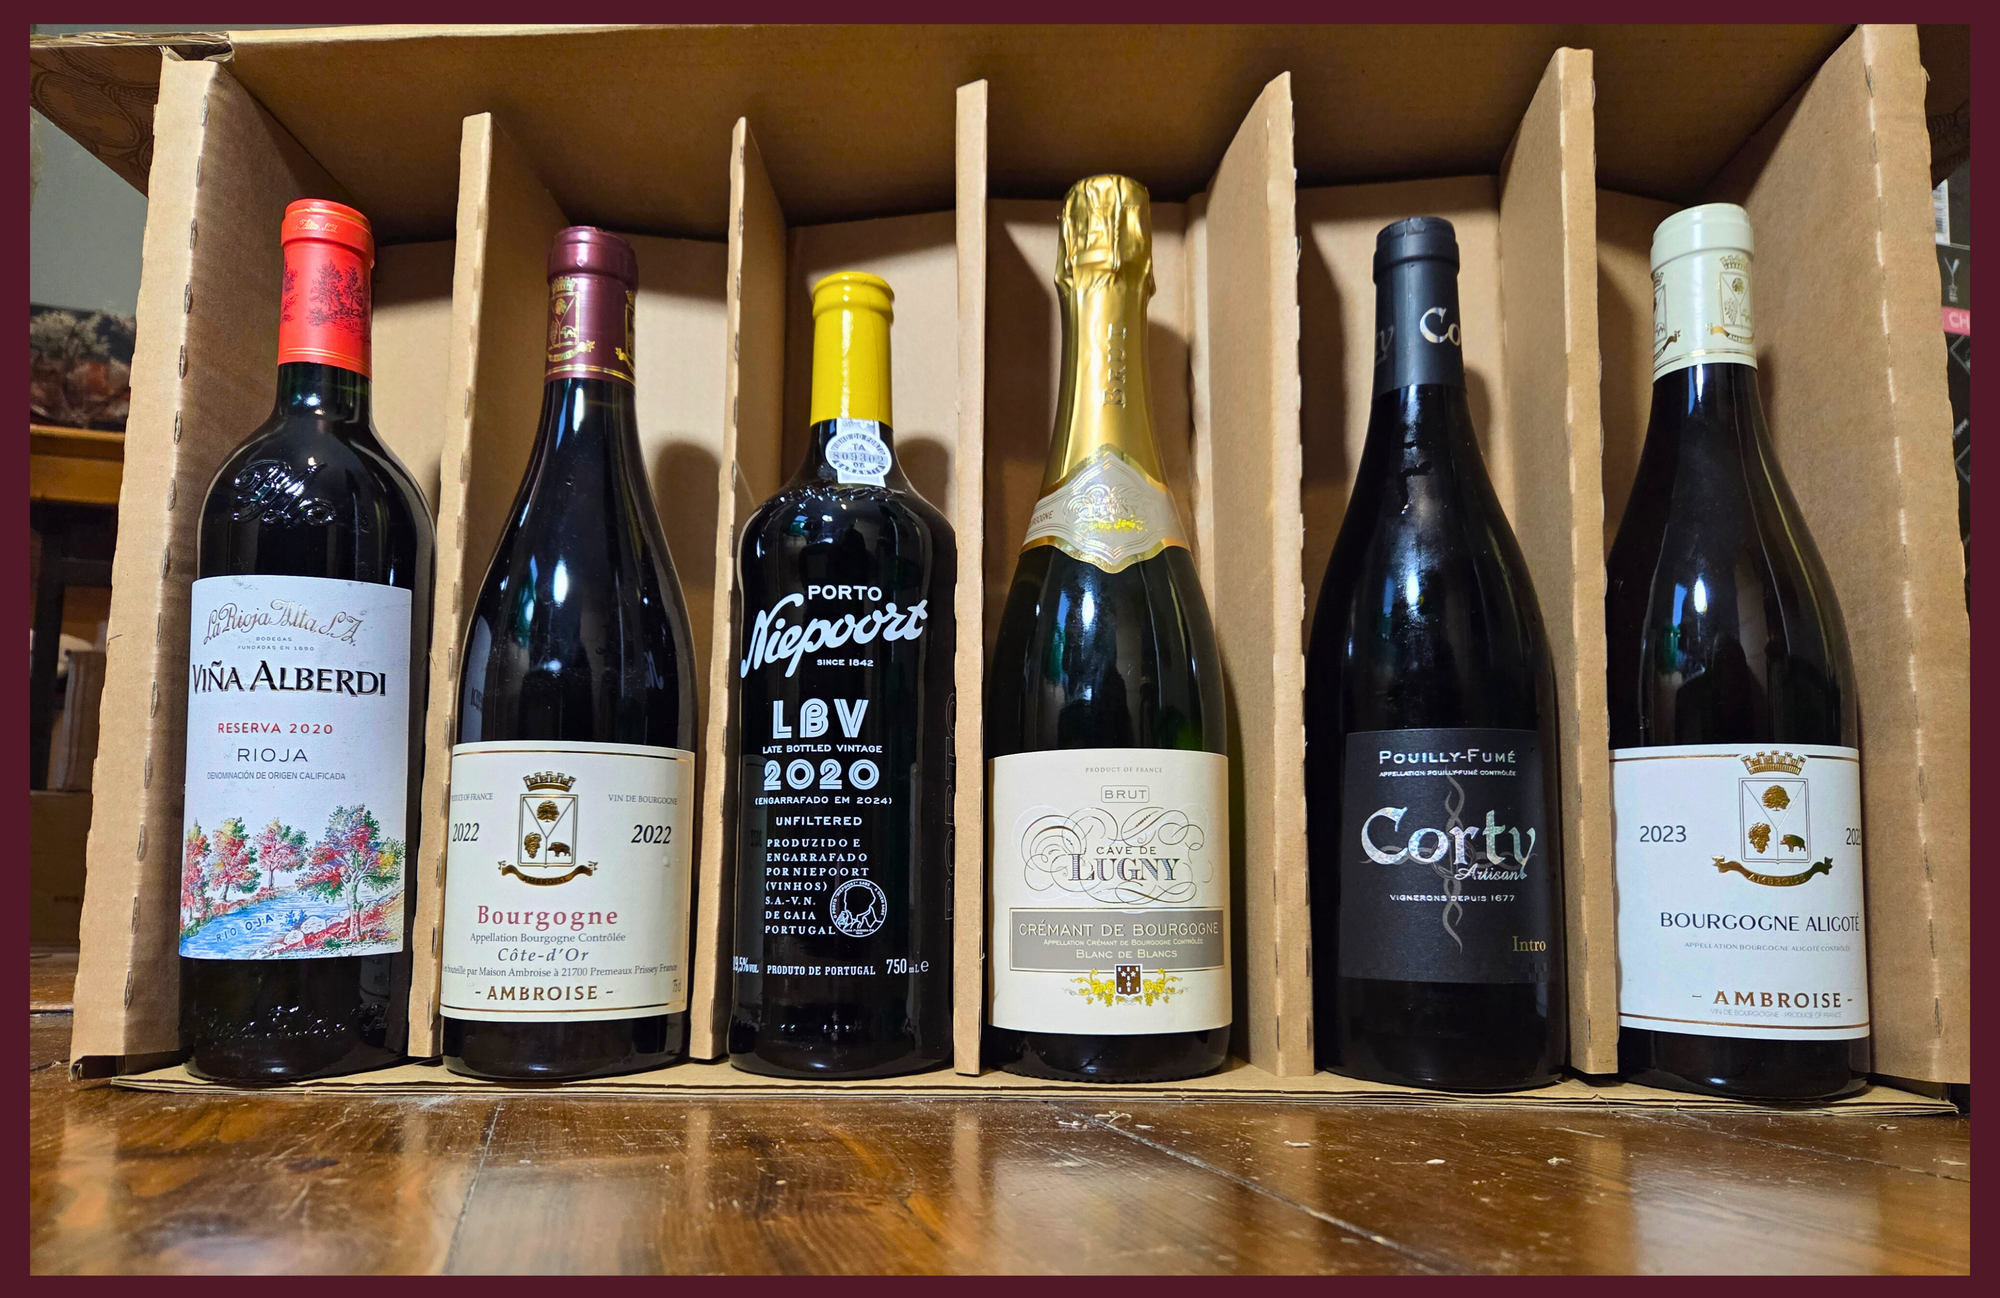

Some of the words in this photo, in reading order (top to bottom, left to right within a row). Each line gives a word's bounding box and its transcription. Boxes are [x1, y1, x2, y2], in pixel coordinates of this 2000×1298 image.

[1419, 306, 1461, 346] Co
[832, 452, 884, 466] 809302
[808, 584, 882, 600] PORTO
[204, 610, 222, 644] La
[218, 602, 270, 633] Rioja
[740, 593, 928, 679] Niepoort
[816, 658, 844, 666] SINCE
[848, 658, 874, 667] 1842
[192, 660, 245, 694] VIÑA
[250, 660, 386, 698] ALBERDI
[772, 698, 869, 739] LBV
[218, 722, 281, 734] RESERVA
[289, 724, 333, 734] 2020
[238, 748, 308, 762] RIOJA
[762, 746, 782, 754] LATE
[786, 744, 832, 753] BOTTLED
[836, 744, 882, 754] VINTAGE
[1379, 748, 1516, 764] POUILLY-FUMÉ
[207, 769, 254, 780] DENOMINACIÓN
[256, 772, 266, 780] DE
[268, 772, 298, 780] ORIGEN
[300, 772, 346, 780] CALIFICADA
[764, 758, 880, 791] 2020
[608, 794, 624, 802] VIN
[626, 794, 636, 803] DE
[638, 796, 678, 806] BOURGOGNE
[755, 796, 828, 806] (ENGARRAFADO
[834, 796, 850, 804] EM
[856, 796, 892, 805] 2024)
[1104, 790, 1147, 800] BRUT
[776, 816, 862, 826] UNFILTERED
[452, 822, 480, 842] 2022
[631, 824, 672, 844] 2022
[1640, 825, 1687, 842] 2023
[766, 838, 848, 848] PRODUZIDO
[853, 838, 860, 848] E
[1361, 806, 1536, 879] Corty
[766, 853, 868, 862] ENGARRAFADO
[1096, 846, 1132, 855] CAVE
[1140, 847, 1156, 855] DE
[766, 868, 790, 876] POR
[792, 868, 870, 876] NIEPOORT
[1068, 854, 1180, 881] LUGNY
[1454, 863, 1520, 882] Artisan
[766, 881, 828, 892] (VINHOS)
[1390, 894, 1448, 902] VIGNERONS
[478, 905, 618, 931] Bourgogne
[765, 911, 780, 919] DE
[784, 910, 816, 920] GAIA
[1660, 912, 1800, 932] BOURGOGNE
[1805, 912, 1860, 932] ALIGOTÉ
[215, 928, 238, 943] RIO
[245, 914, 274, 932] OJA
[765, 926, 836, 934] PORTUGAL
[1018, 919, 1094, 937] CRÉMANT
[1102, 924, 1125, 937] DE
[1133, 922, 1218, 937] BOURGOGNE
[470, 933, 518, 945] Appellation
[520, 933, 575, 945] Bourgogne
[578, 932, 626, 942] Contrôlée
[1086, 938, 1117, 946] CRÉMANT
[1512, 936, 1546, 952] Intro
[1684, 942, 1738, 950] APPELLATION
[1076, 949, 1113, 959] BLANC
[1118, 950, 1132, 958] DE
[1137, 949, 1178, 958] BLANCS
[467, 968, 478, 978] par
[479, 967, 506, 976] Maison
[508, 966, 551, 977] Ambroise
[554, 968, 559, 976] à
[561, 967, 588, 976] 21700
[590, 966, 633, 976] Premeaux
[634, 964, 658, 977] Prissey
[660, 963, 677, 972] France
[766, 965, 806, 975] PRODUTO
[808, 966, 821, 975] DE
[824, 965, 876, 975] PORTUGAL
[487, 986, 598, 1001] AMBROISE
[1713, 990, 1841, 1008] AMBROISE
[1734, 1009, 1780, 1018] BOURGOGNE
